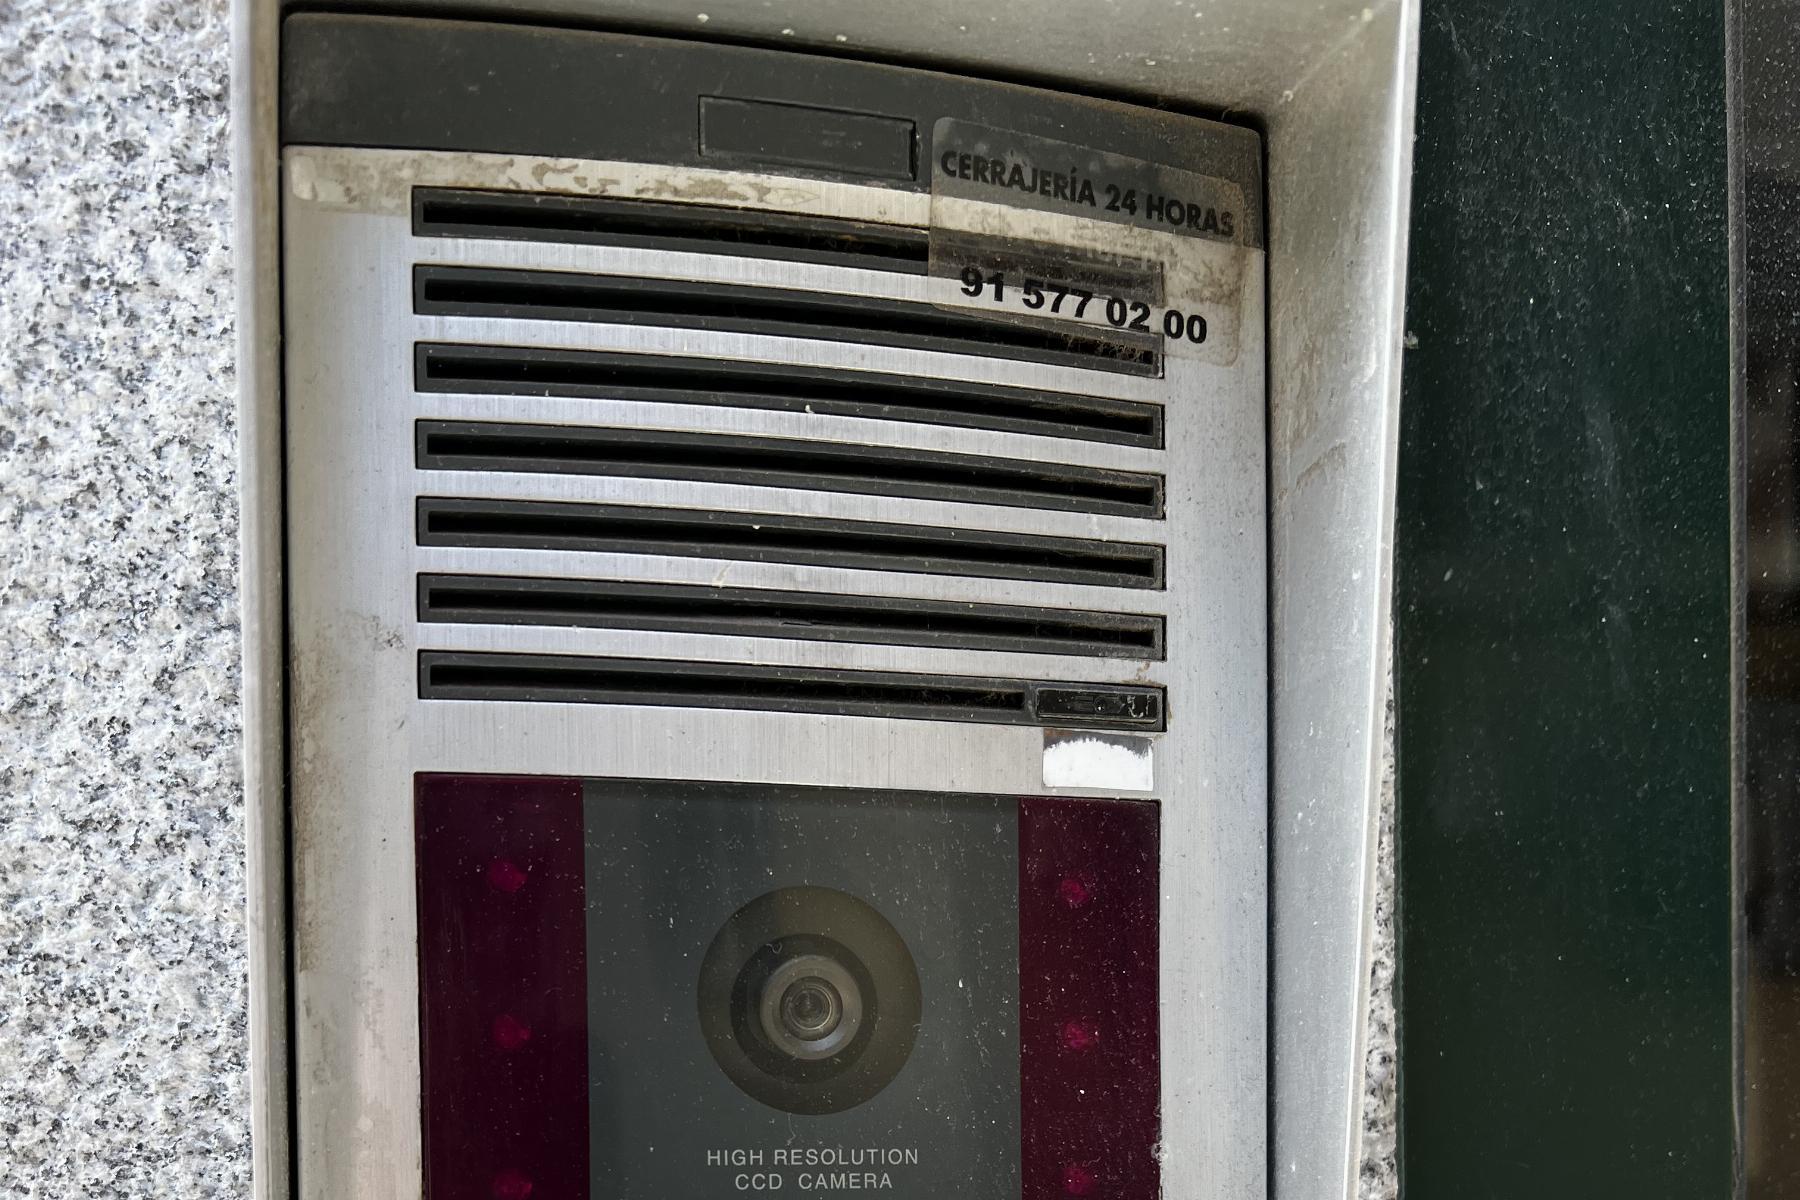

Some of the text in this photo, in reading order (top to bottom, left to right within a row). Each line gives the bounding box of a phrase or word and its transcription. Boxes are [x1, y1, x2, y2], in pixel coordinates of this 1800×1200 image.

[941, 151, 1235, 238] CERRAJERÍA 24 HORAS
[960, 266, 1208, 344] 91 577 02 00
[706, 1148, 919, 1166] HIGH RESOLUTION
[735, 1173, 893, 1190] CCD CAMERA
